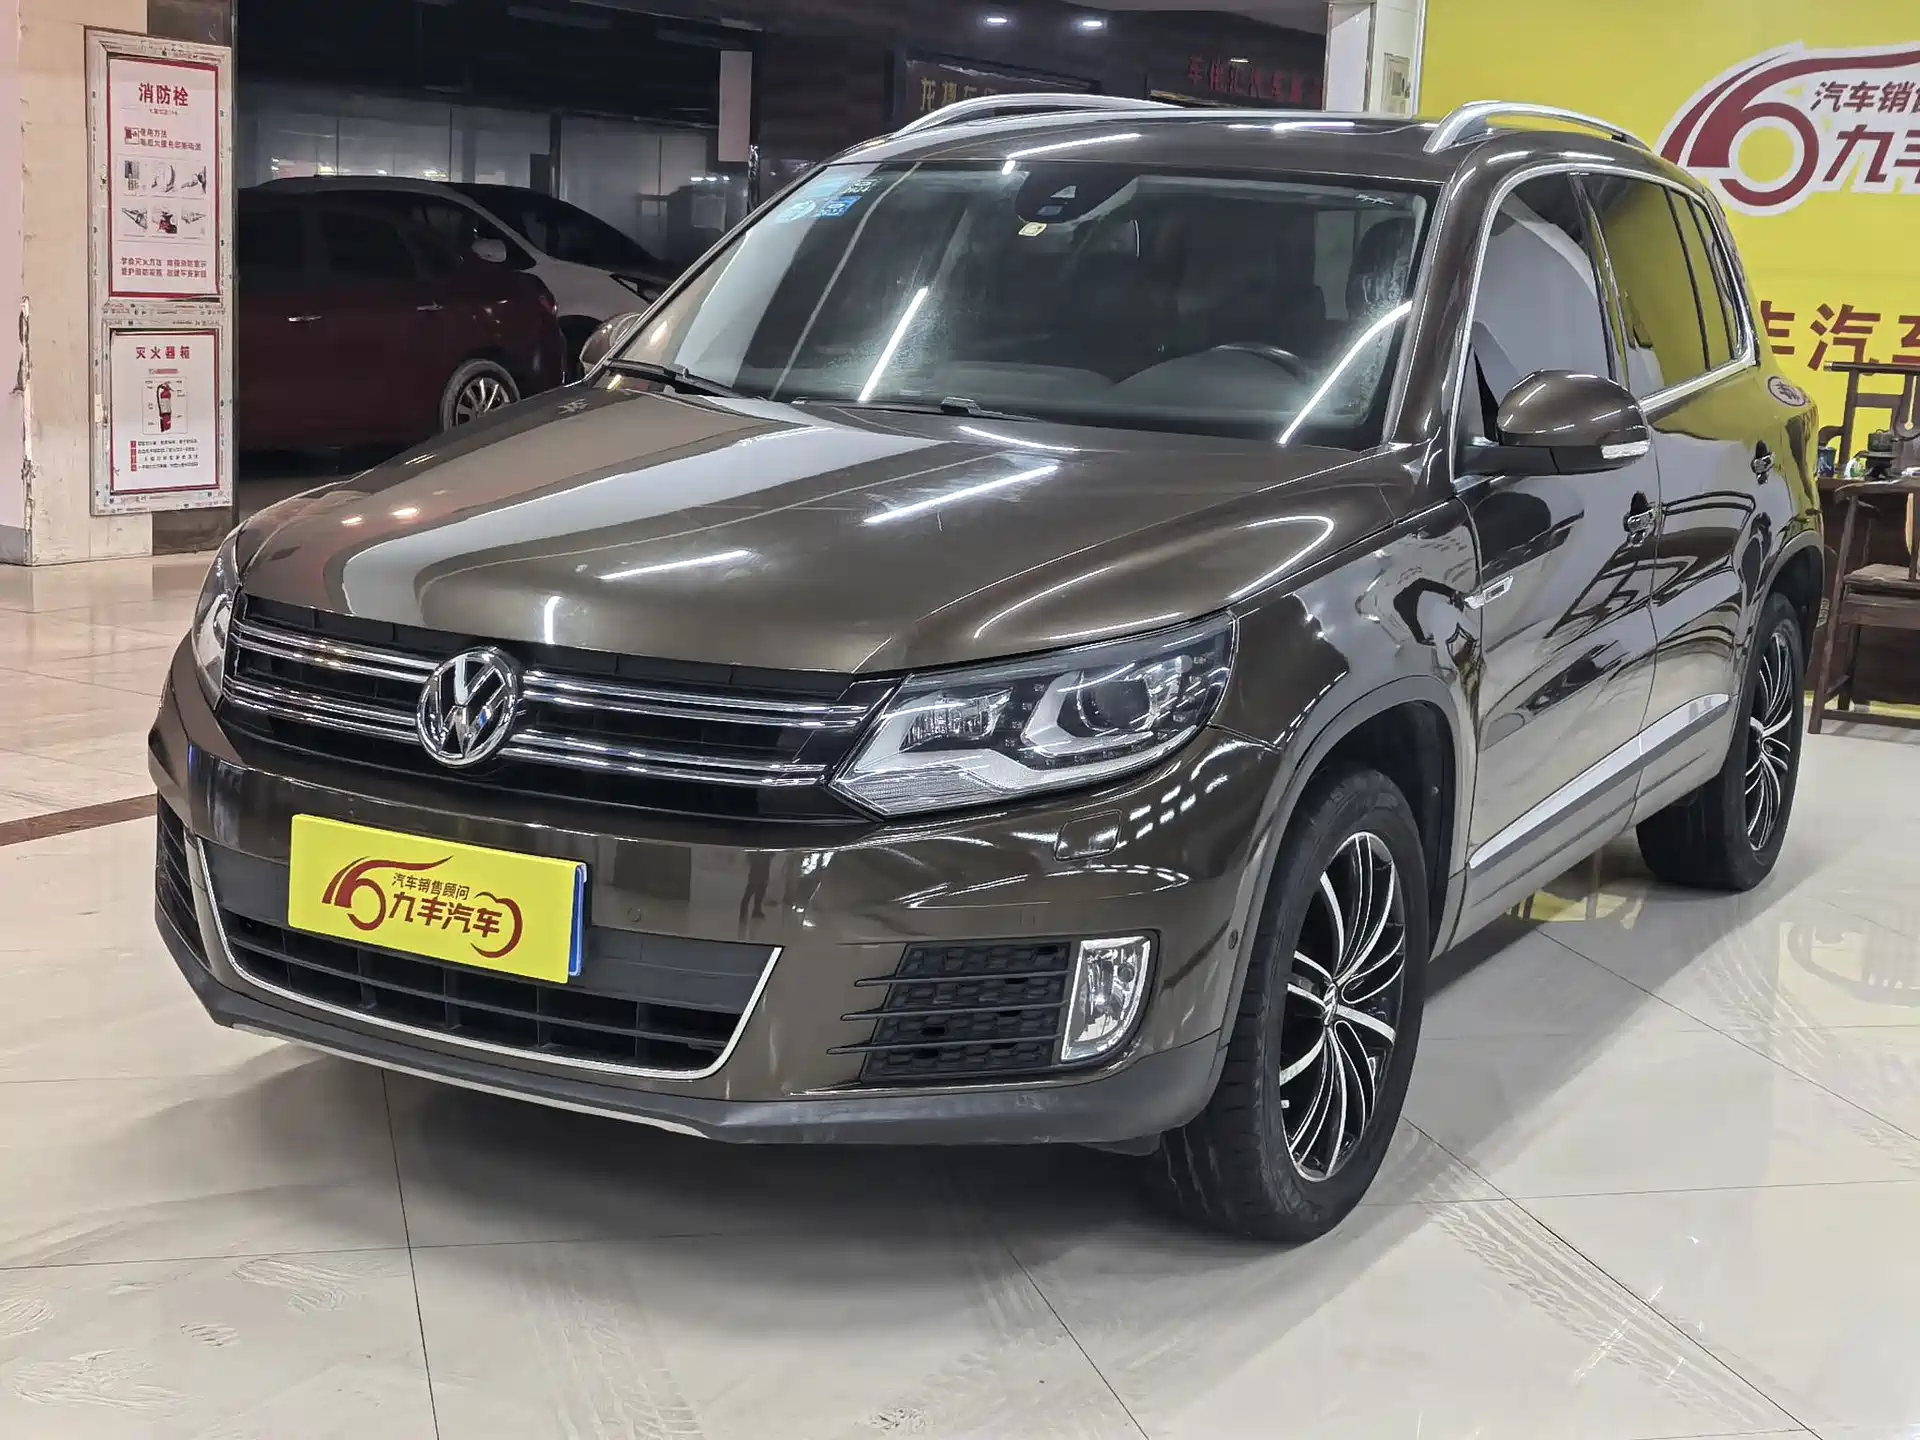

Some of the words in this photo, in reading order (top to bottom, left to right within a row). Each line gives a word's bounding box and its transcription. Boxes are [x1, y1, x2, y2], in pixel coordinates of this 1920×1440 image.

[138, 82, 189, 107] 消防栓
[1810, 80, 1920, 113] 汽车销
[136, 345, 190, 360] 灭火器箱
[391, 872, 470, 900] 汽车销售顾问
[389, 891, 503, 937] 九丰汽车
